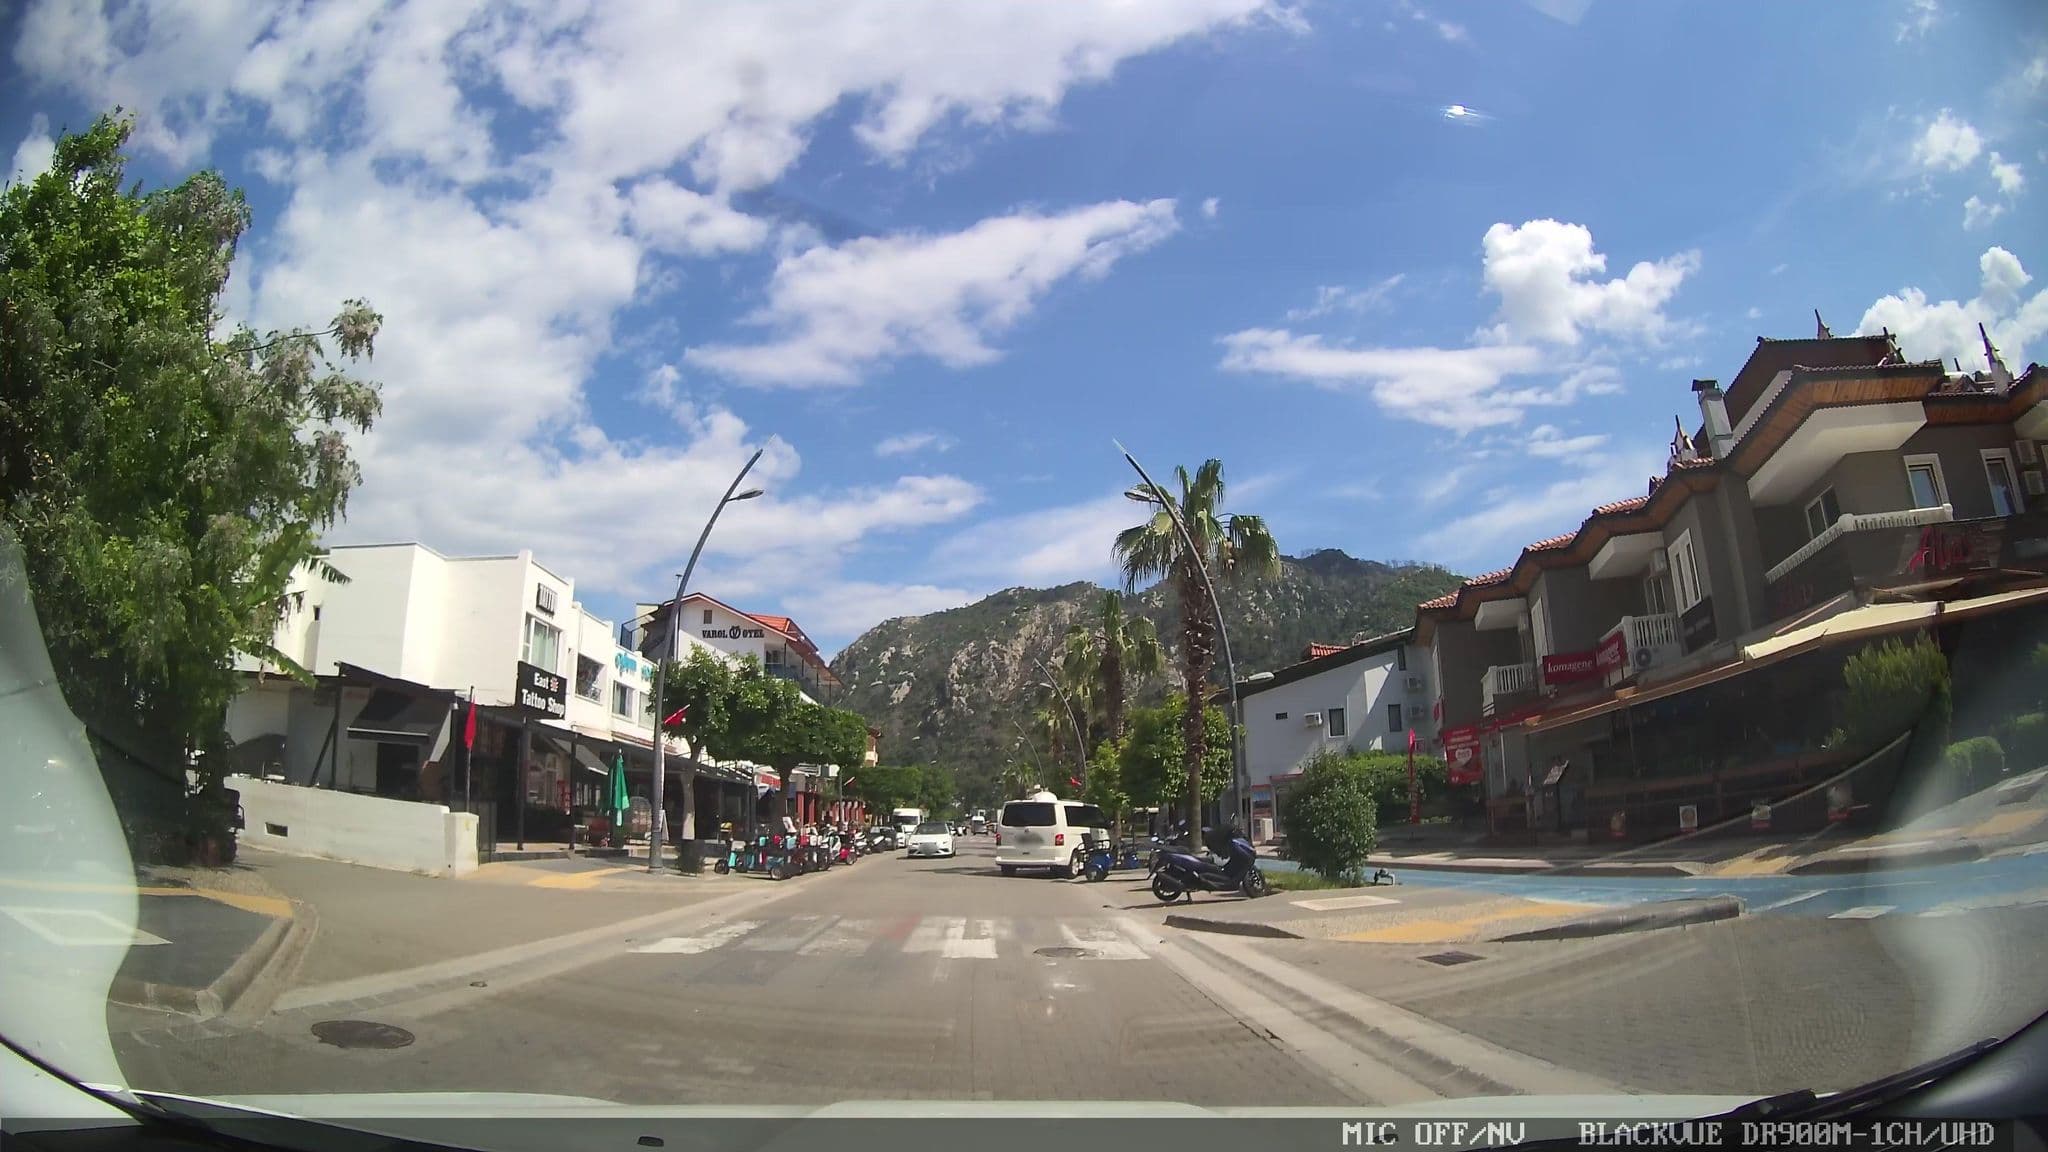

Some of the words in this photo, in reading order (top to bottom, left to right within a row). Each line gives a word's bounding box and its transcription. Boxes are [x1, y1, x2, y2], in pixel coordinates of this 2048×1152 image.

[702, 629, 728, 639] VAROL
[742, 629, 765, 639] OTEL
[1547, 660, 1593, 673] komagene
[533, 672, 549, 690] East
[521, 688, 547, 711] Tattoo
[547, 696, 565, 718] Shop
